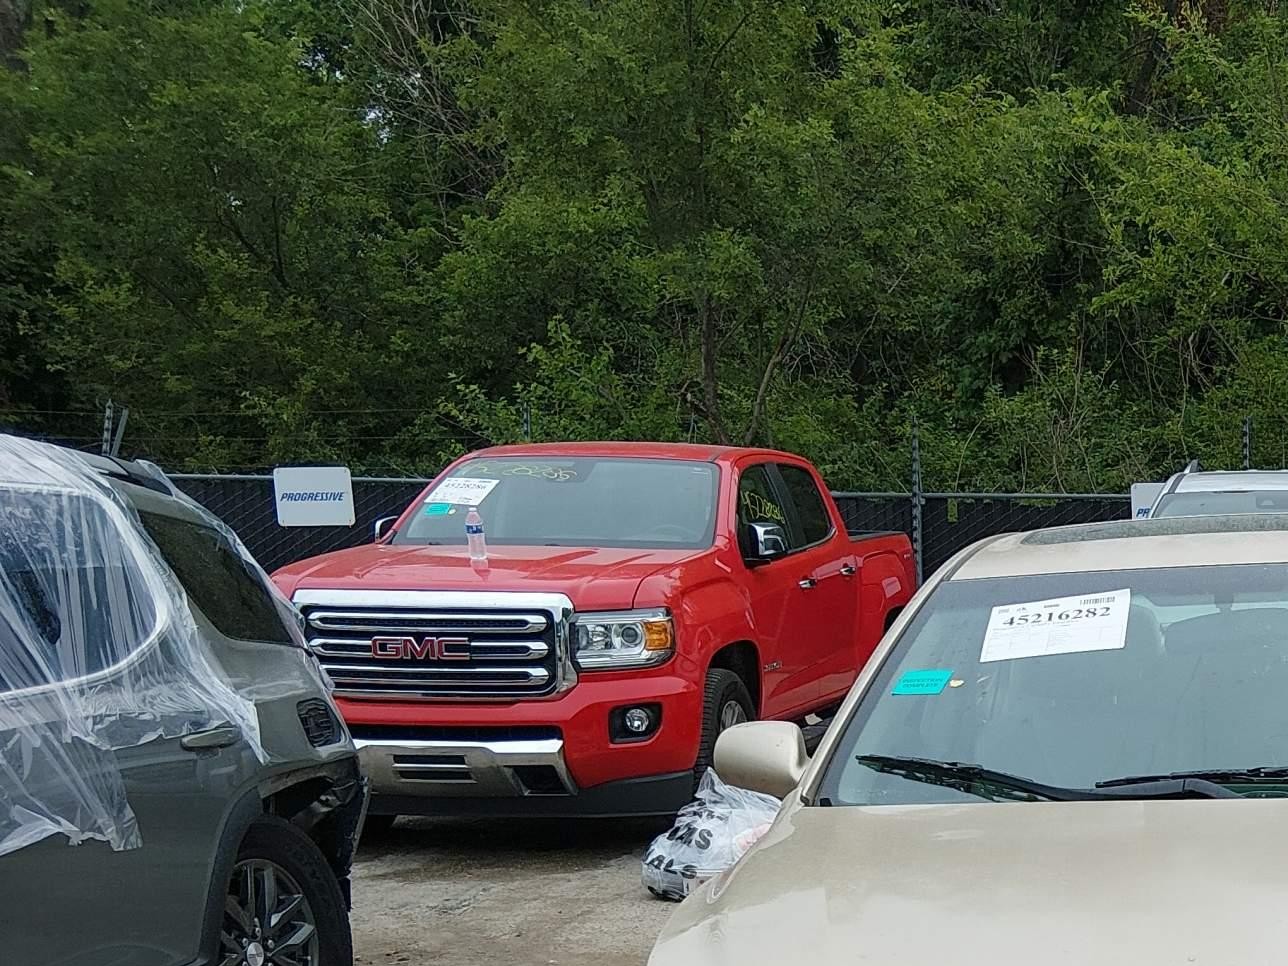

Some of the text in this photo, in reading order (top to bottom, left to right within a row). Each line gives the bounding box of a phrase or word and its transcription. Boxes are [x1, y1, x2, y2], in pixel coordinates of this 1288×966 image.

[280, 491, 344, 501] PROGRESSIVE
[1003, 606, 1111, 626] 45216282
[371, 636, 470, 660] GMC
